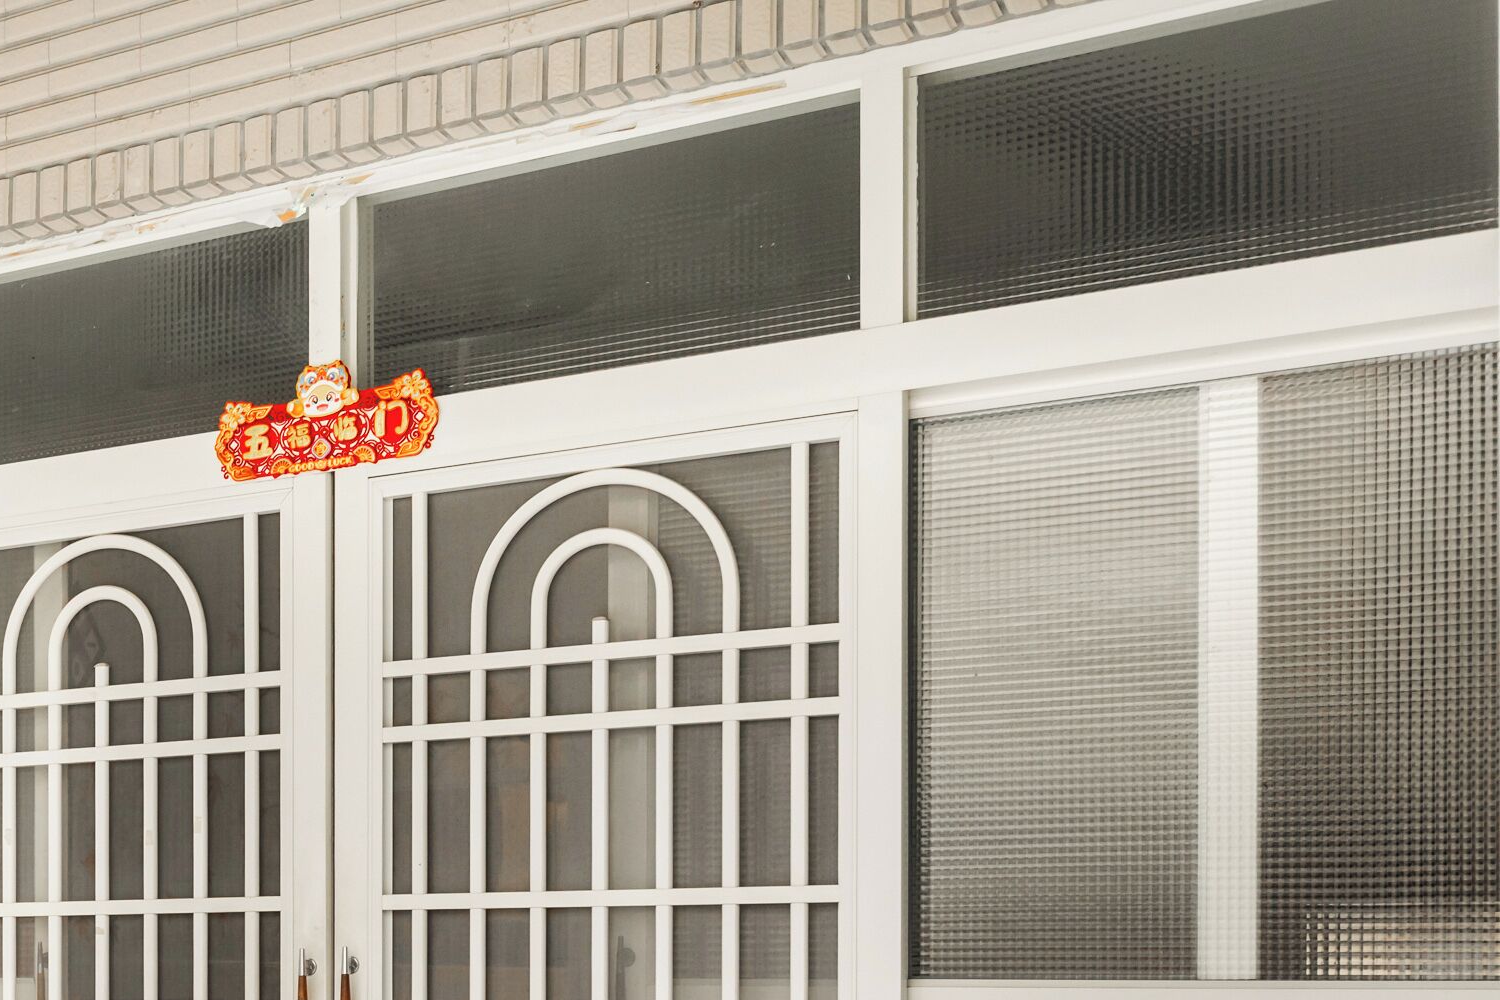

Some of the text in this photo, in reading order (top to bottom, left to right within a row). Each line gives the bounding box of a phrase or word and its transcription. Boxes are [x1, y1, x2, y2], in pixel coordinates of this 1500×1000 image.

[242, 400, 410, 461] 五福临门
[288, 455, 354, 474] GOOD LUCK
